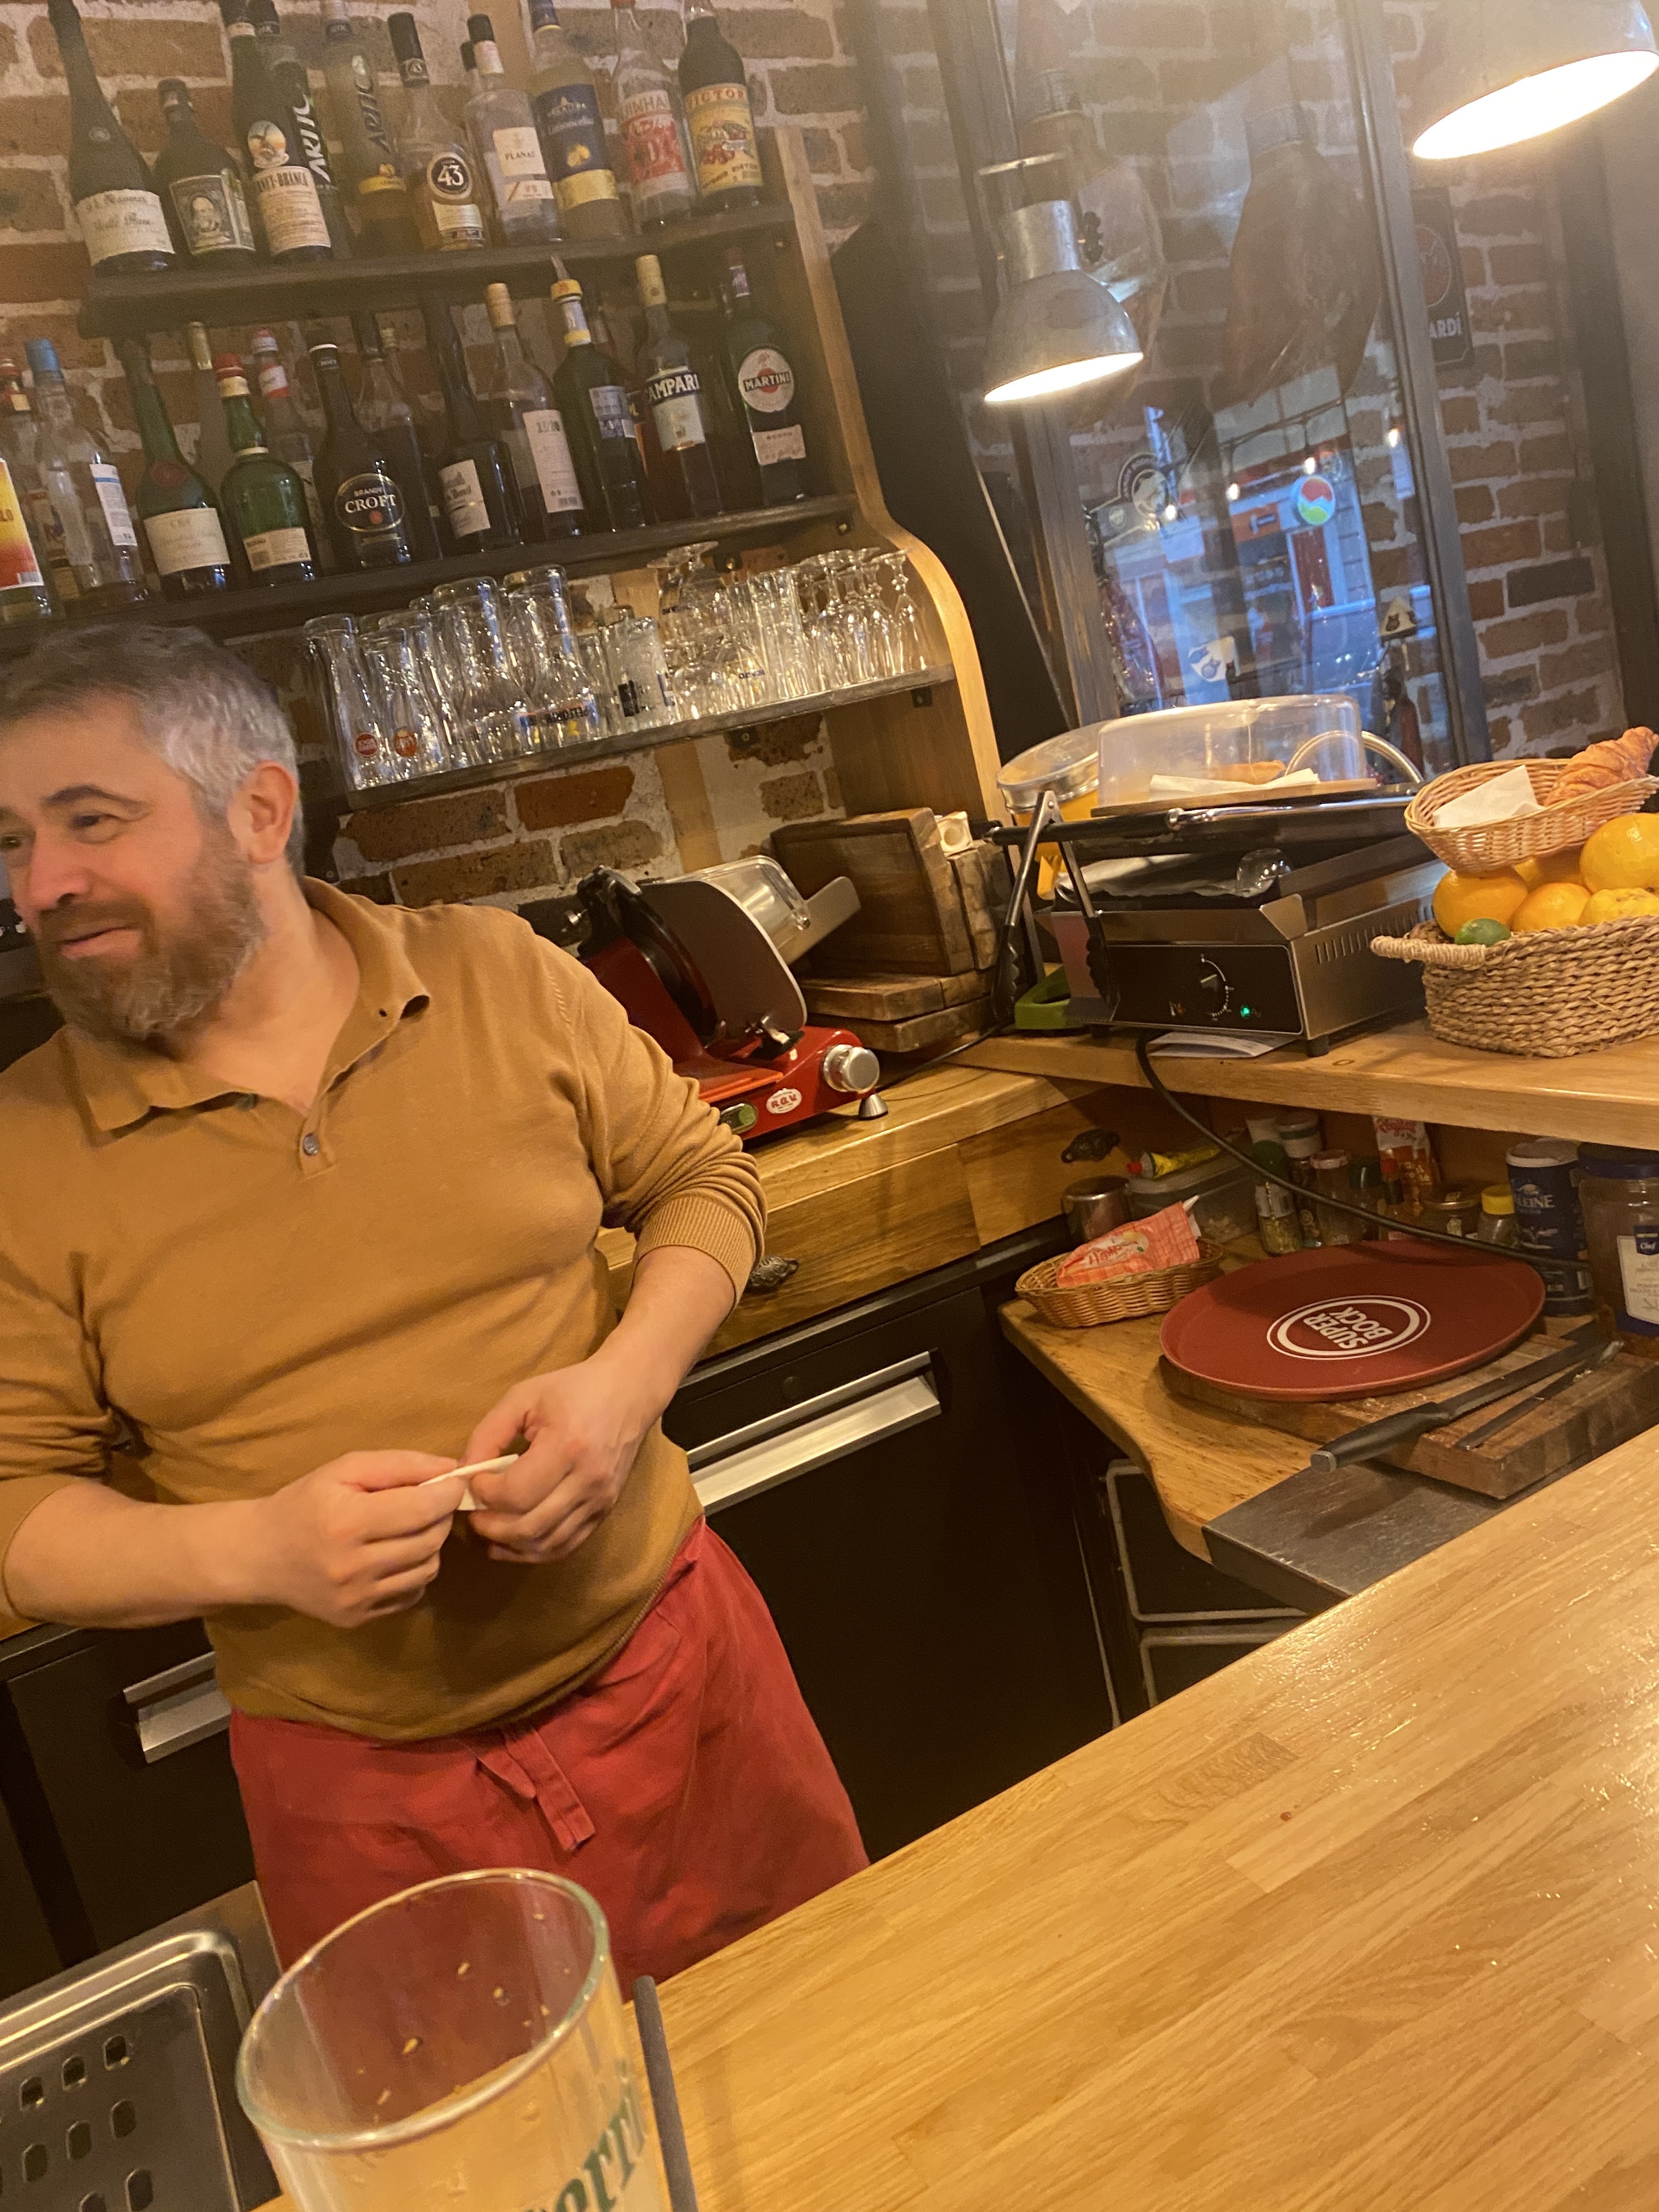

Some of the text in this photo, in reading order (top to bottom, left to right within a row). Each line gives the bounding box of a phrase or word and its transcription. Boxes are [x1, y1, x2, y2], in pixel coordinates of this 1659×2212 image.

[437, 164, 464, 186] 43
[648, 373, 699, 400] AMPARI
[744, 371, 791, 392] MARTINI
[345, 494, 396, 514] CROFT
[1304, 1312, 1369, 1349] SUPER
[1329, 1306, 1393, 1340] BOCK
